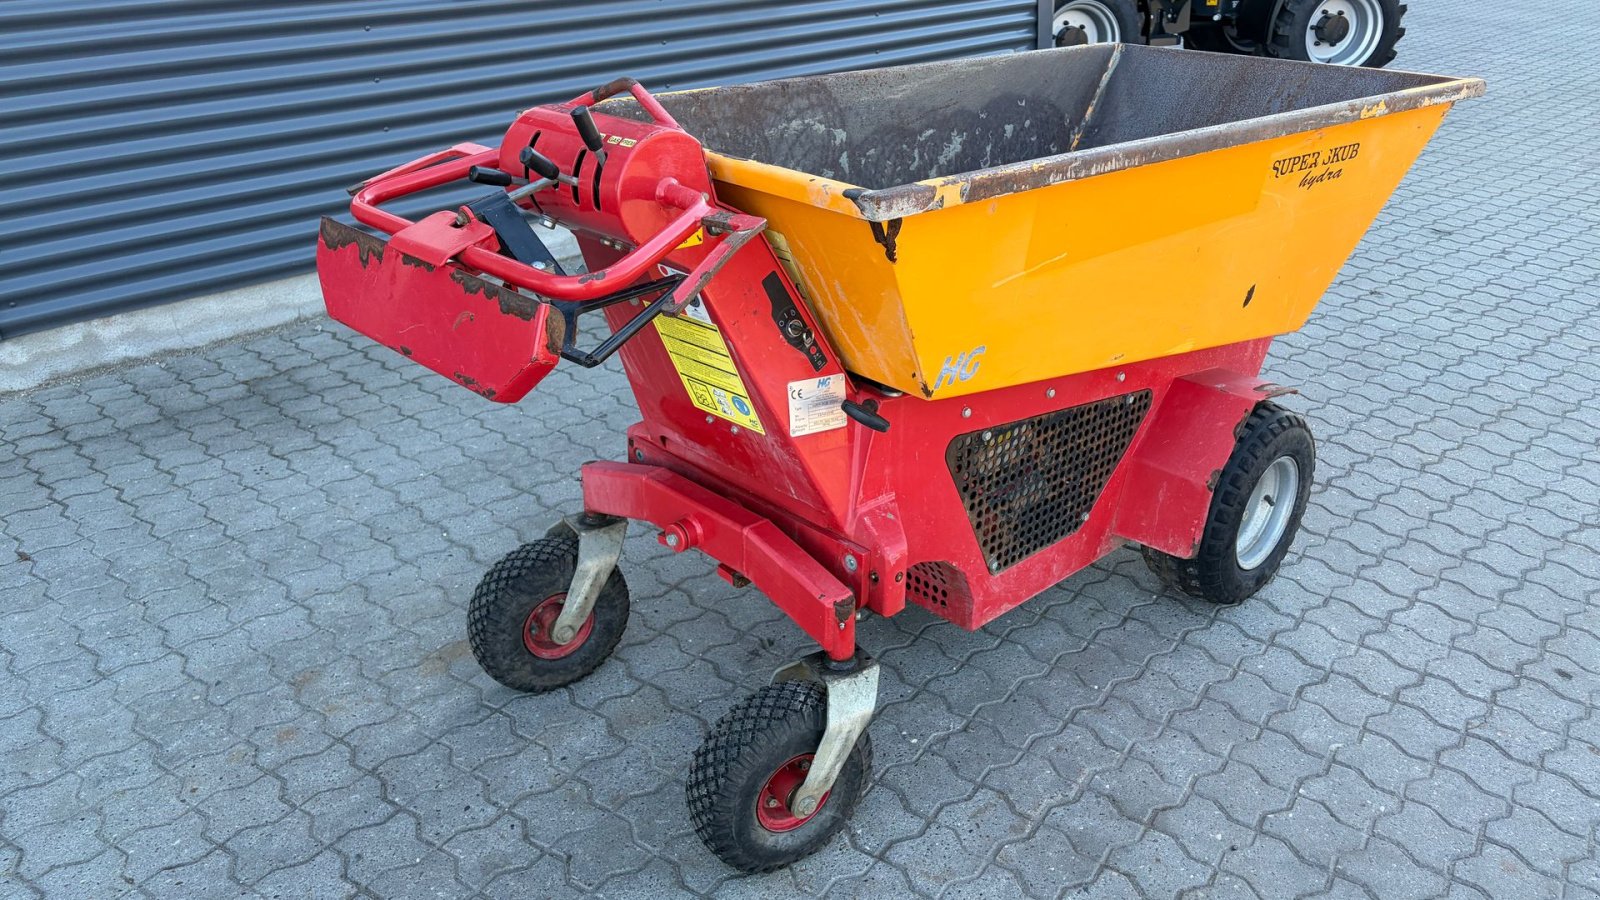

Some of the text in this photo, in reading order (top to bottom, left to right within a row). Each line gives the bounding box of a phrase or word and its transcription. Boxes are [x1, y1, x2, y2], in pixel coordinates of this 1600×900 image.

[1272, 151, 1320, 178] SUPER
[1298, 167, 1343, 190] hydra
[934, 345, 986, 389] HG
[791, 388, 803, 400] CE
[817, 377, 832, 389] HG
